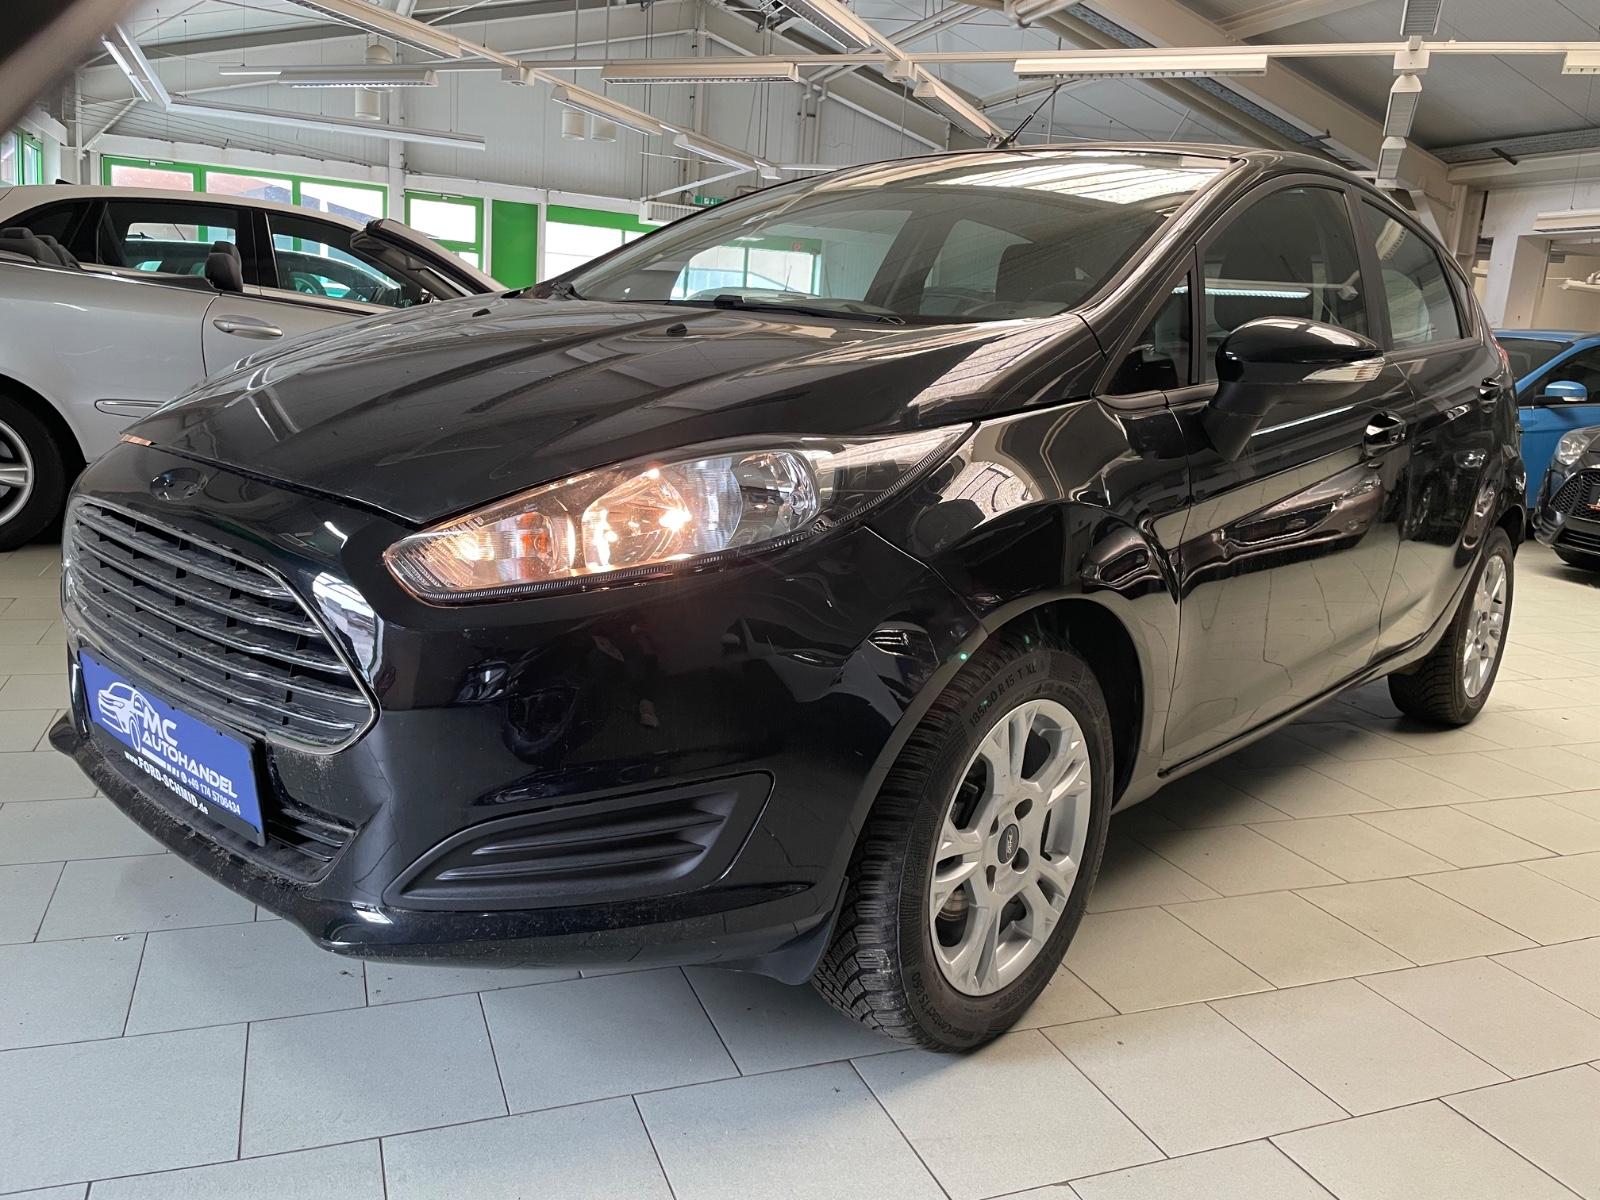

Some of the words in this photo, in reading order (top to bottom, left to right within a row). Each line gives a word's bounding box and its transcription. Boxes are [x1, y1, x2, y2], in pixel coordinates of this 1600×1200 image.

[997, 683, 1006, 696] R
[1005, 675, 1016, 690] 15
[143, 707, 177, 746] MC
[124, 750, 209, 815] www.FORD-SCHMID.de
[141, 730, 238, 799] AUTOHANDEL
[200, 783, 212, 799] 174
